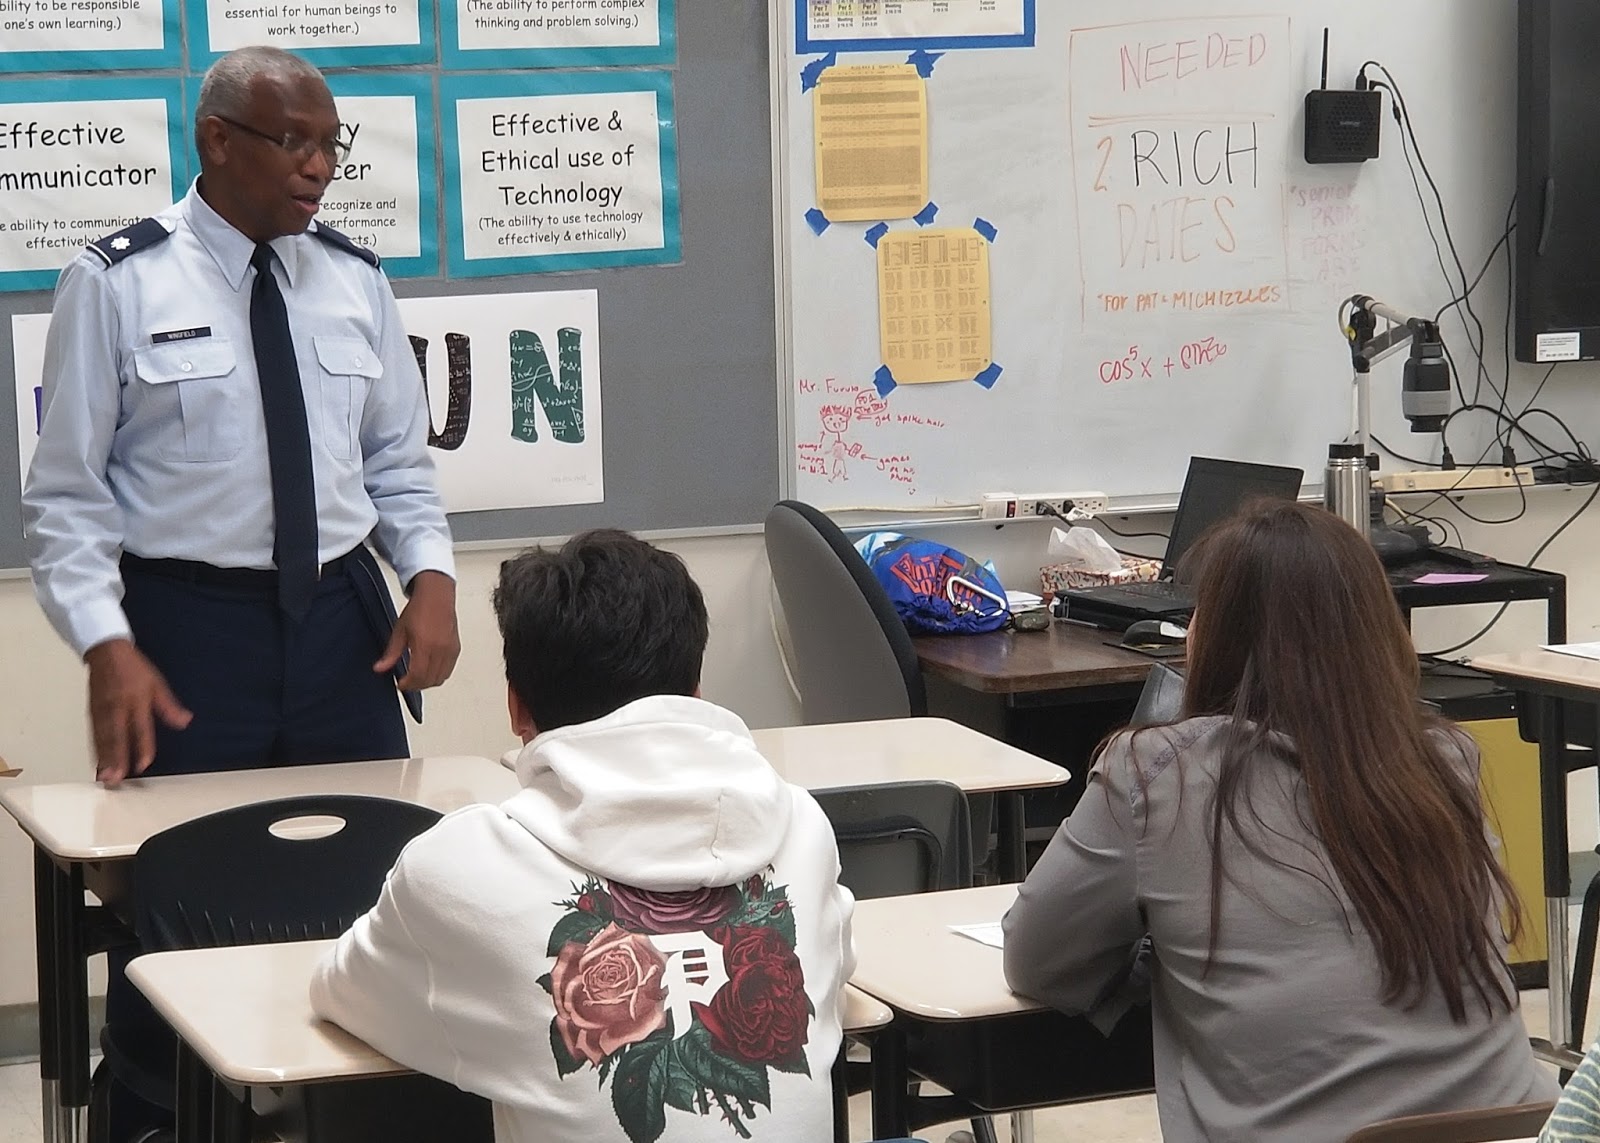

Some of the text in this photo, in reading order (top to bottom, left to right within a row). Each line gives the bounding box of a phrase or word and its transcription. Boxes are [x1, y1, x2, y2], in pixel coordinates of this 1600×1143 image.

[35, 1, 48, 11] to
[52, 0, 67, 10] be
[71, 0, 141, 13] responsible
[225, 4, 397, 19] essential for human beings to
[496, 0, 532, 12] ability
[536, 0, 548, 9] to
[551, 0, 597, 12] perform
[601, 0, 645, 11] complex
[4, 16, 122, 31] one's own learning.)
[268, 22, 360, 37] work together.)
[475, 14, 639, 30] thinking and problem solving.)
[1120, 32, 1267, 92] NEEDED
[491, 110, 623, 137] Effective &
[481, 144, 635, 173] Ethical use of
[1131, 122, 1258, 188] RICH
[498, 180, 623, 208] Technology
[376, 197, 397, 209] and
[10, 218, 49, 232] ability
[53, 218, 66, 229] to
[478, 210, 643, 231] (The ability to use technology
[498, 227, 627, 245] effectively & ethically)
[1117, 195, 1236, 269] DATES
